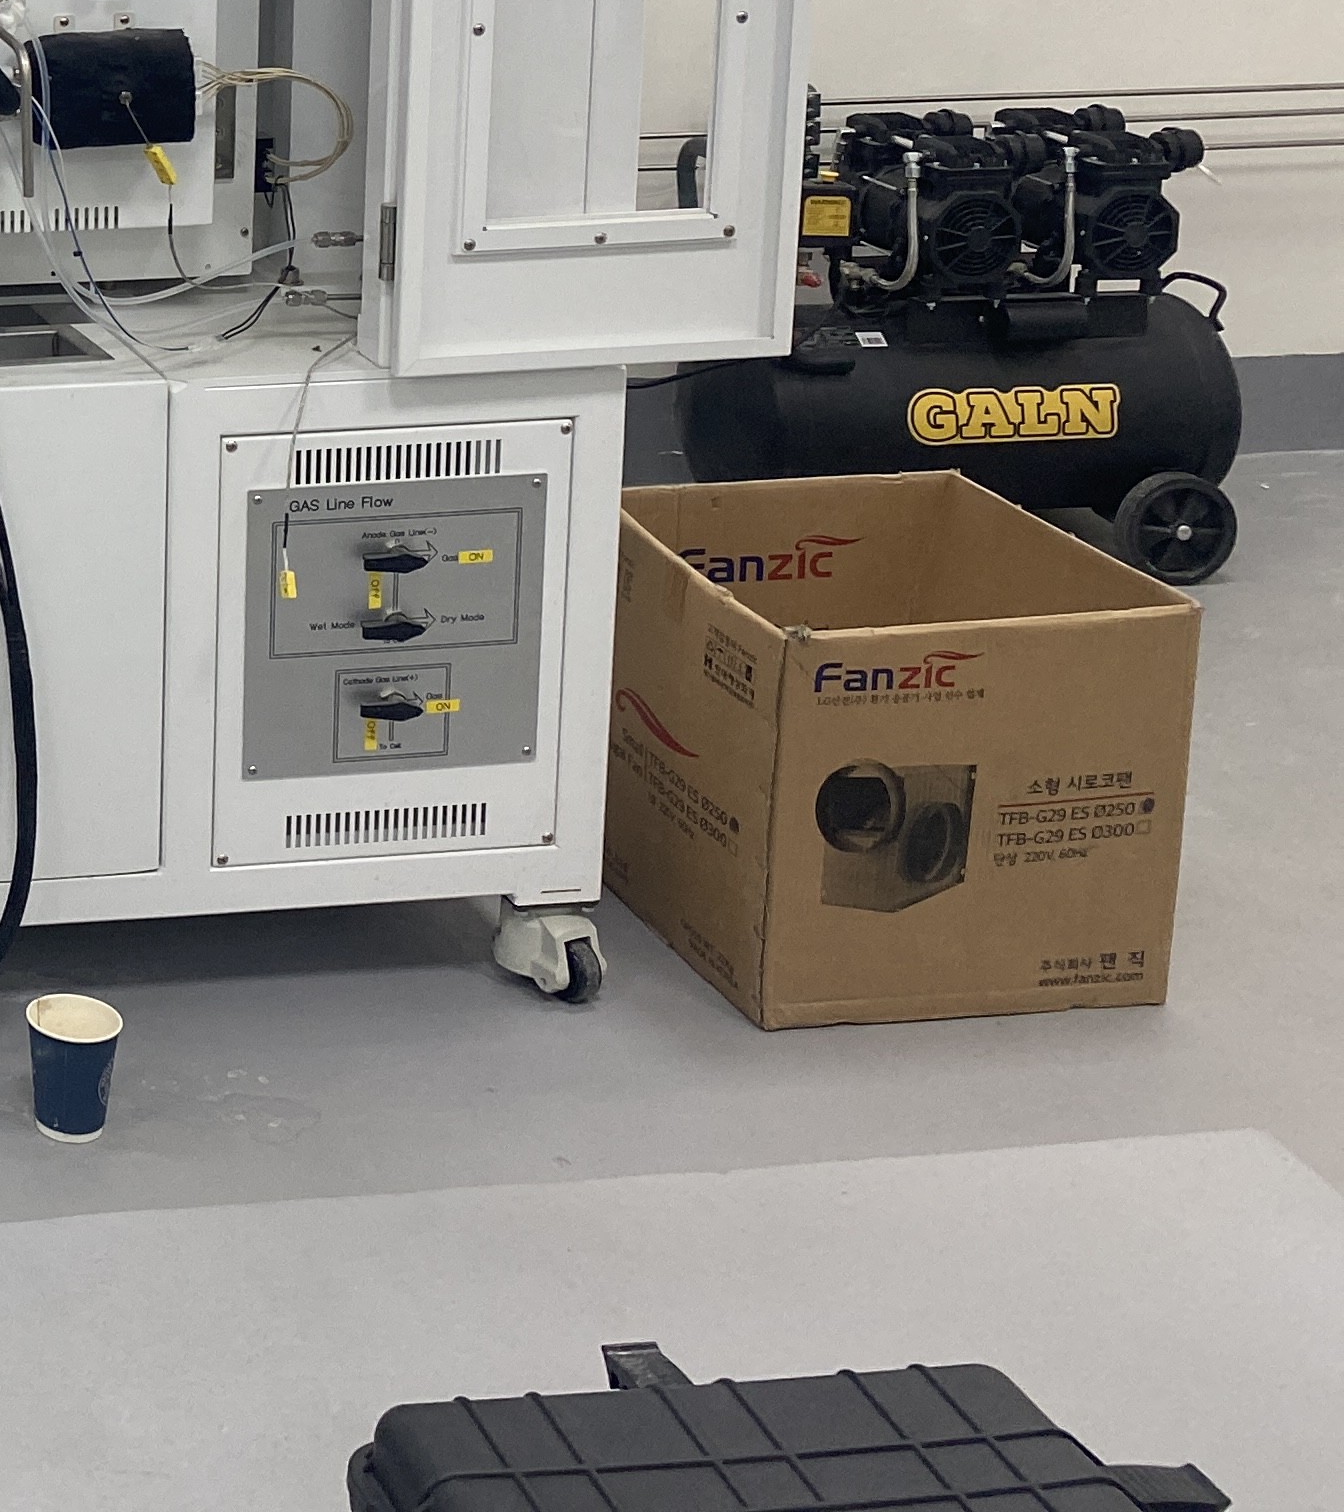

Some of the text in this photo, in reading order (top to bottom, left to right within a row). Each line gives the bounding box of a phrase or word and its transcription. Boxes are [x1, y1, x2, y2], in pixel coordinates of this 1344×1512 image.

[911, 385, 1117, 444] GALN
[289, 496, 393, 512] GAS Line Flow
[468, 553, 484, 561] ON
[310, 621, 355, 631] Wet Mode
[441, 613, 485, 624] Dry Mode
[814, 652, 958, 693] Fanzic
[436, 702, 451, 711] ON
[1026, 777, 1061, 796] 소형
[998, 807, 1066, 826] TFB-G29
[1071, 805, 1090, 820] ES
[996, 828, 1064, 847] TFB-G29
[1068, 827, 1087, 841] ES
